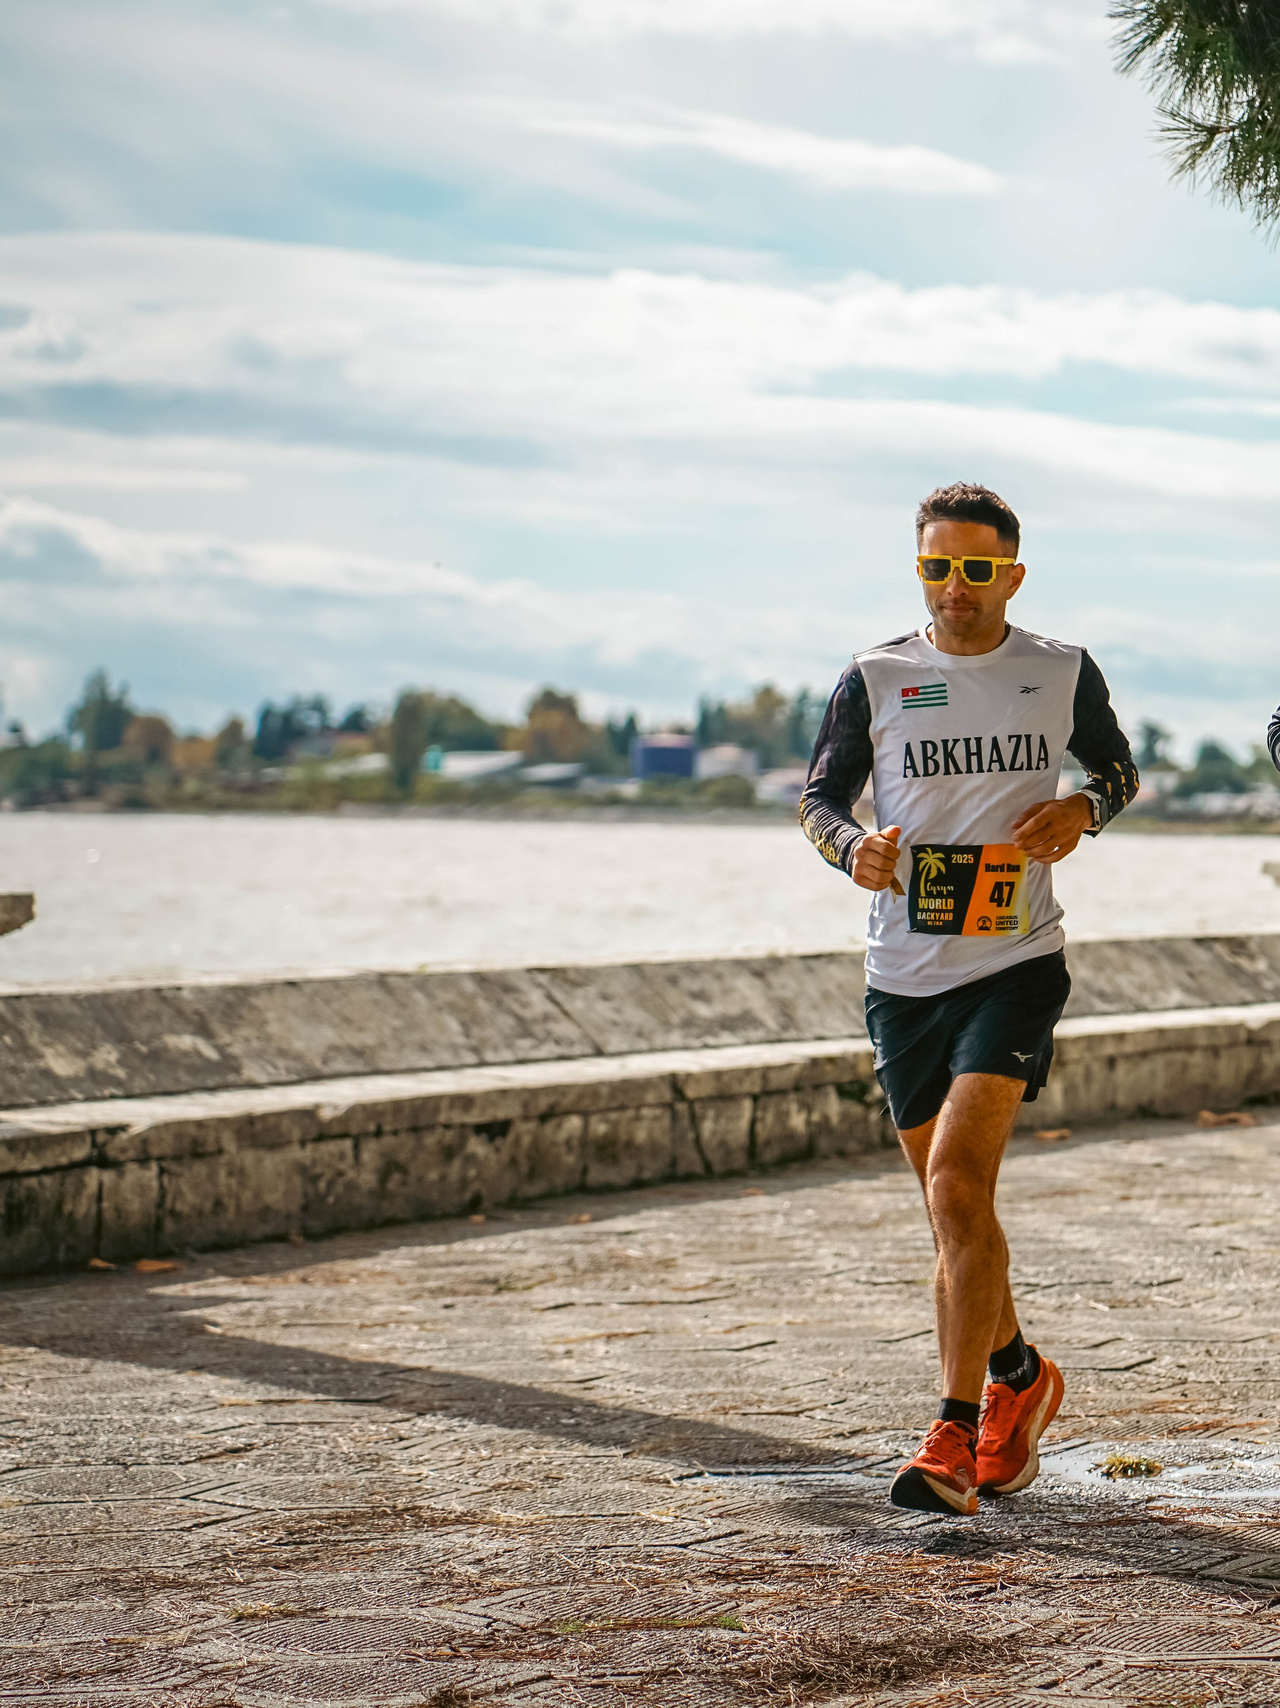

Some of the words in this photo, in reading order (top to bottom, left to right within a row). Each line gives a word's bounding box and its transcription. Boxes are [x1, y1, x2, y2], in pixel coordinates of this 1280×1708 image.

[902, 733, 1049, 778] ABKHAZIA
[951, 854, 974, 864] 2025
[985, 863, 1005, 873] Hard
[1006, 863, 1020, 873] Run
[989, 881, 1015, 908] 47
[918, 898, 954, 910] WORLD
[917, 911, 953, 921] BACKYARD
